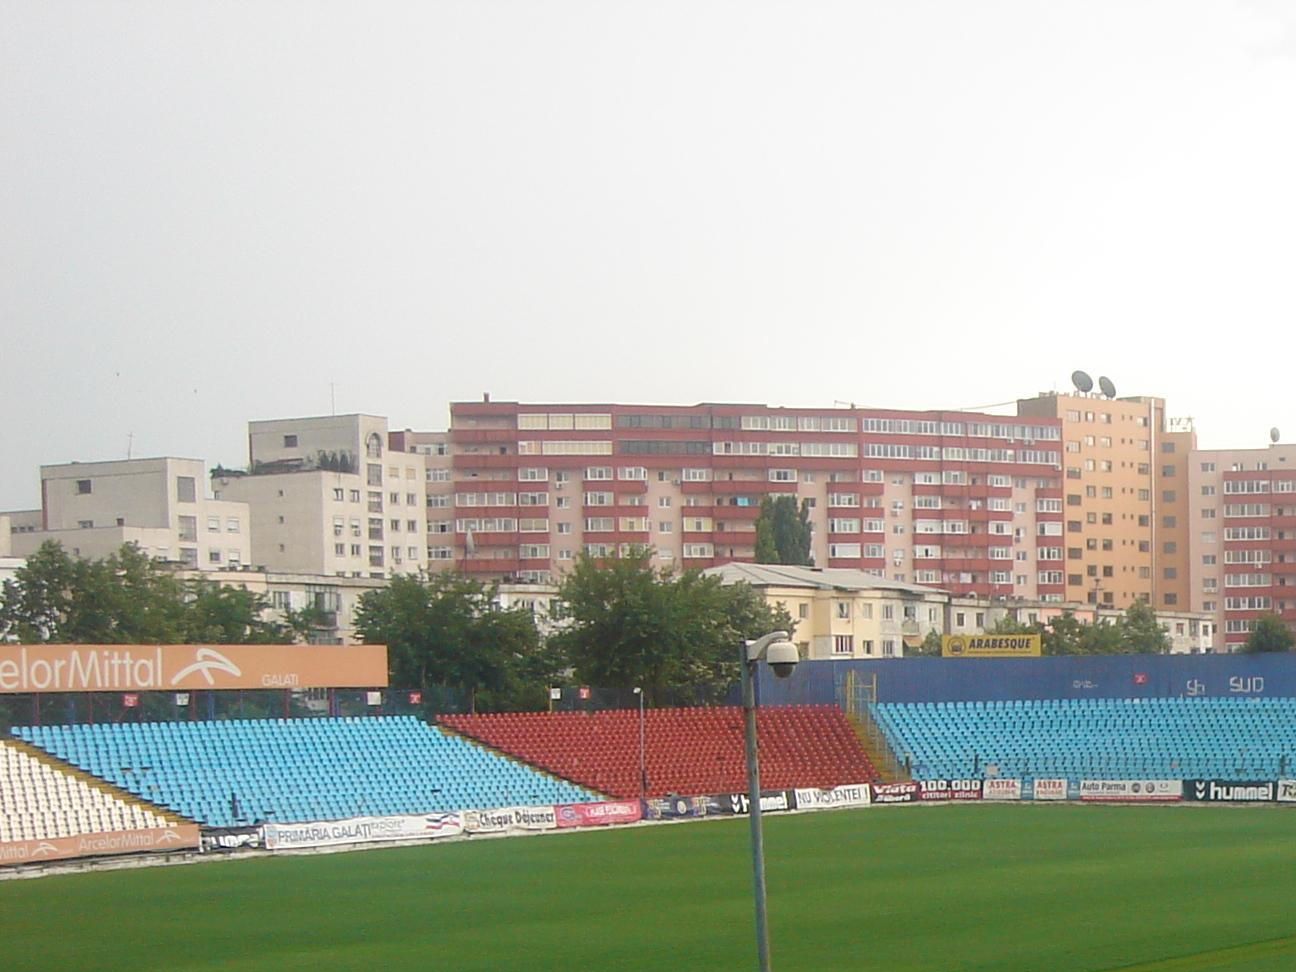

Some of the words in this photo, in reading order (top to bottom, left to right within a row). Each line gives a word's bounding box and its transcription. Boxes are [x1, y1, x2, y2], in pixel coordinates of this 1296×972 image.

[969, 638, 1031, 649] ARABESQUE
[920, 780, 980, 791] 100.000
[1081, 782, 1100, 791] Auto
[1210, 782, 1273, 800] hummel
[740, 791, 788, 813] hmmel
[79, 833, 154, 851] ArcelorMittal
